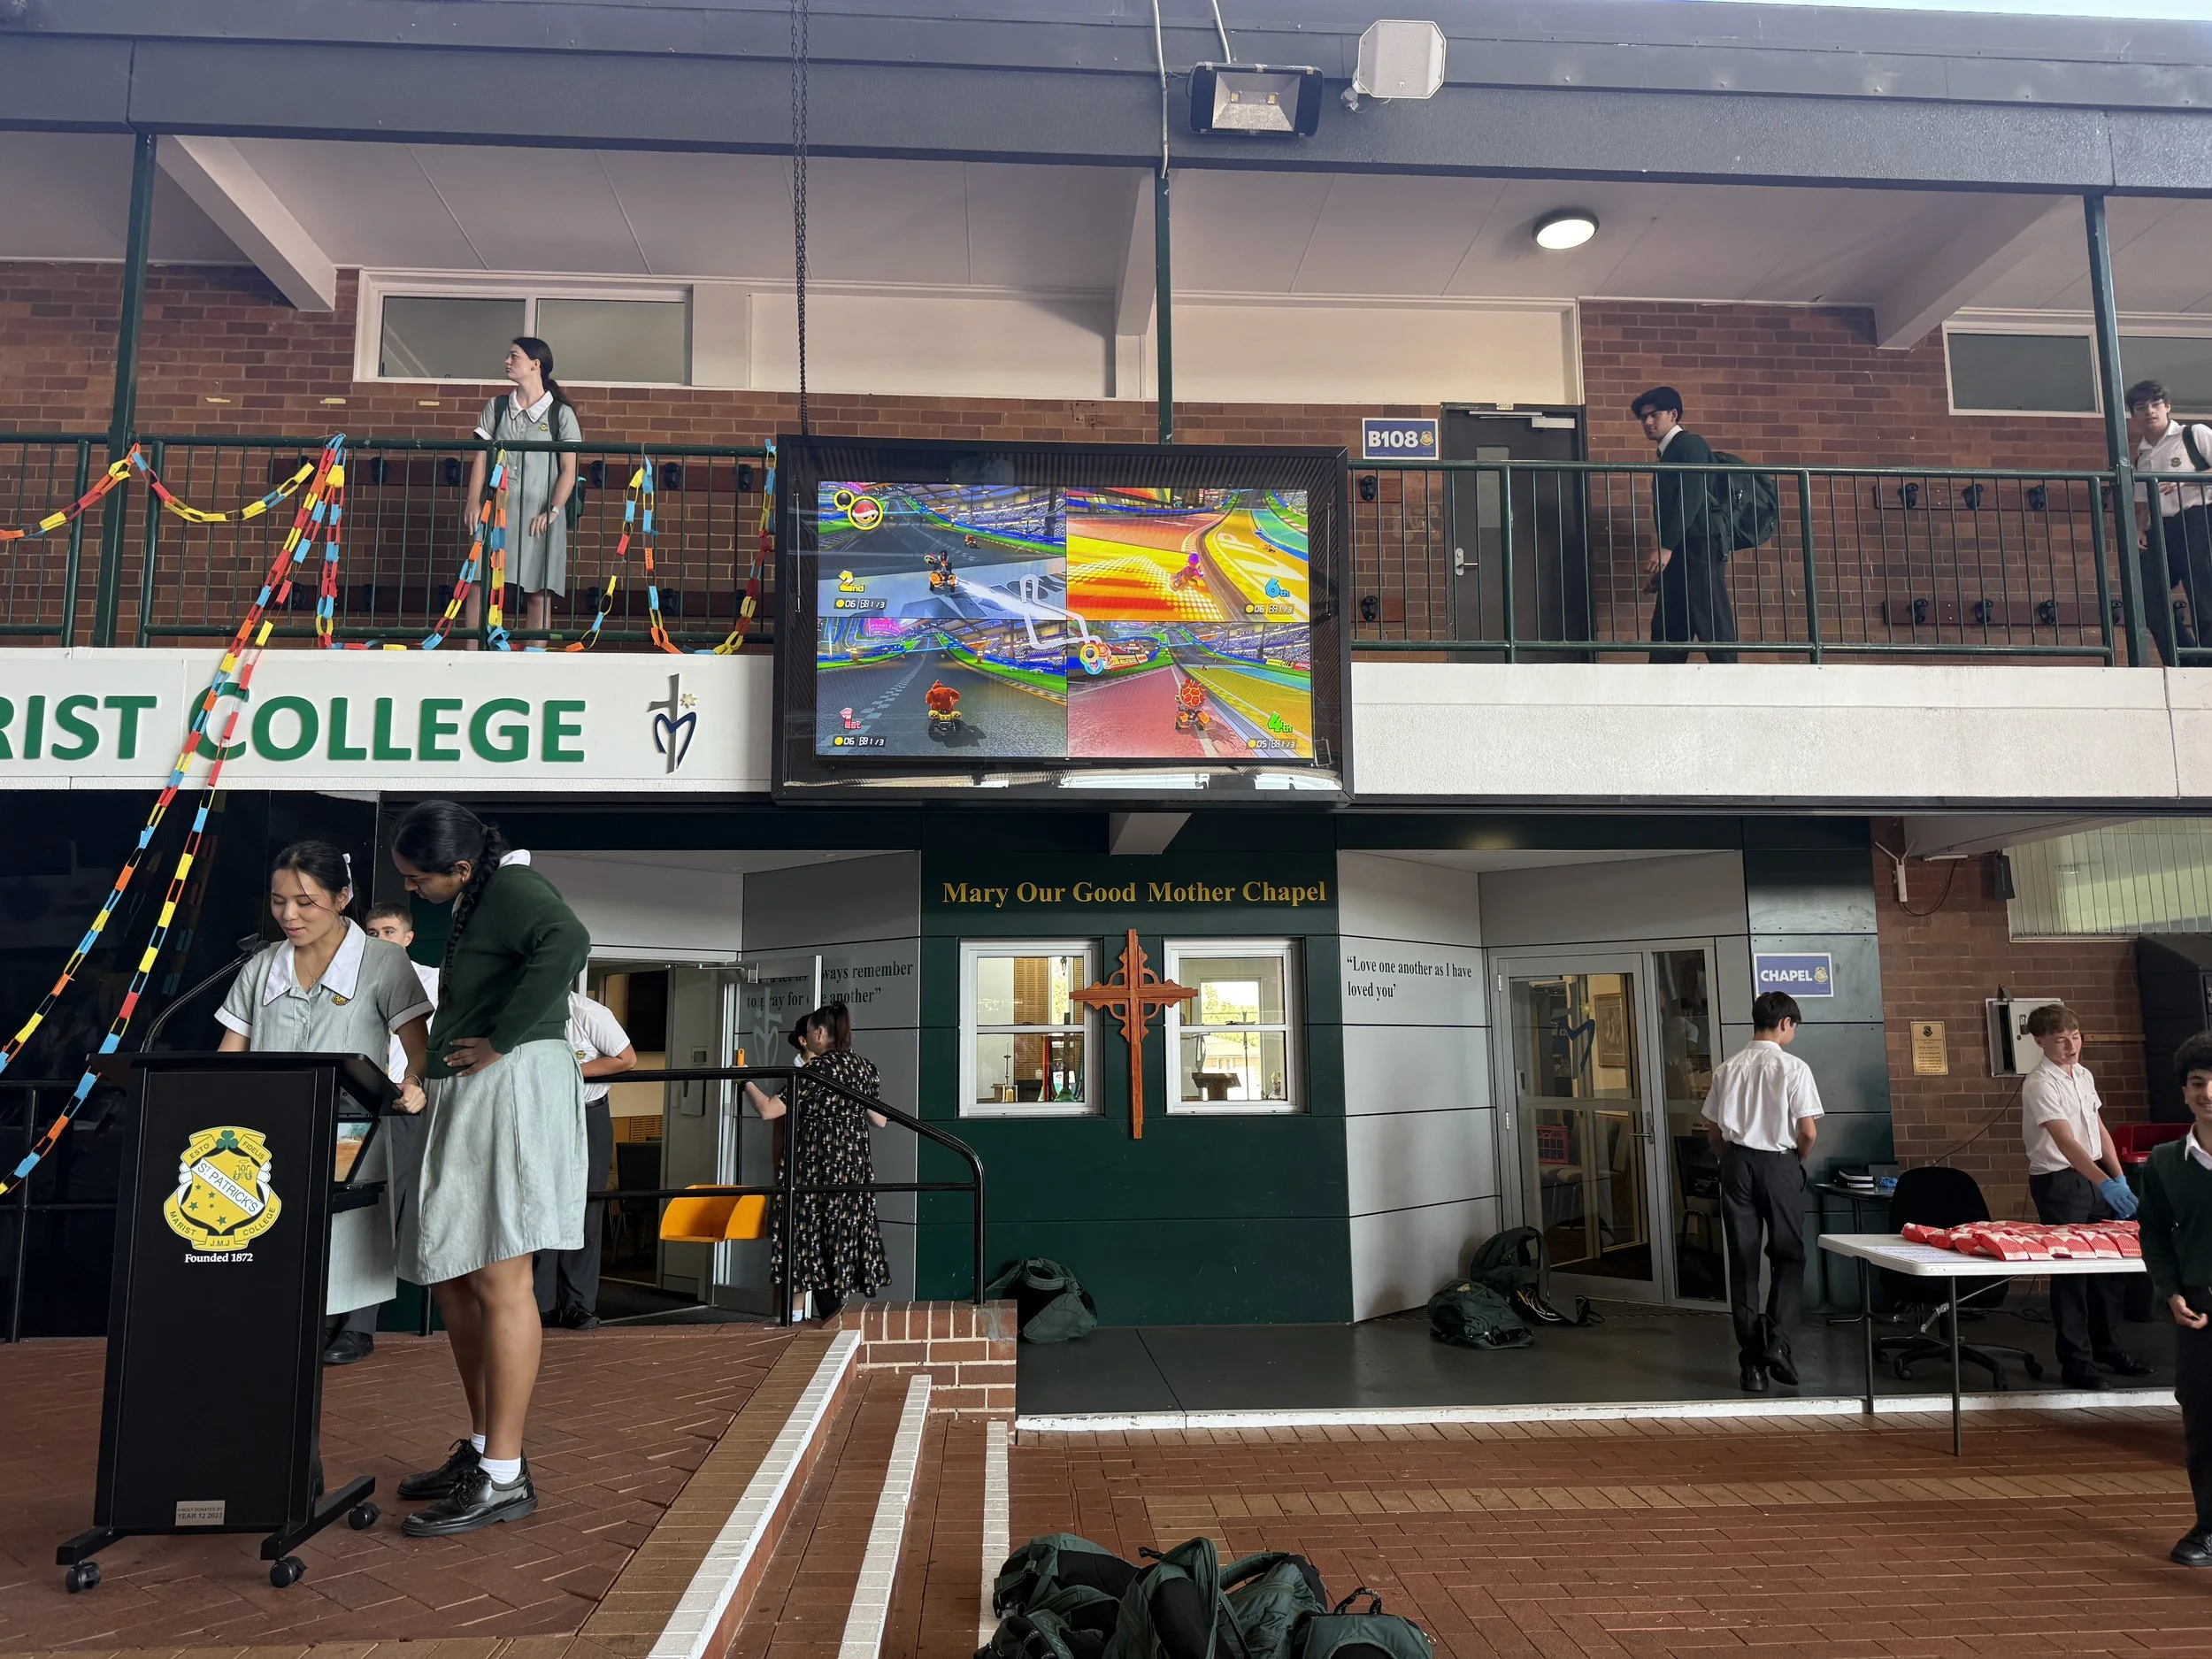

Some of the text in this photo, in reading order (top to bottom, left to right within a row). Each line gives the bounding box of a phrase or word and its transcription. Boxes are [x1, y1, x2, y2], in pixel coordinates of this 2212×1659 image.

[1368, 431, 1418, 448] B108
[839, 570, 864, 592] 2nd
[1265, 577, 1290, 598] 6th
[188, 682, 586, 763] COLLEGE
[840, 707, 861, 729] 1st
[1268, 711, 1293, 733] 4th
[942, 881, 1326, 908] Mary Our Good Mother Chapel
[821, 967, 849, 984] ways
[852, 960, 913, 979] remember
[1347, 956, 1472, 978] “Love one another as I have
[1760, 970, 1813, 982] CHAPEL
[747, 995, 757, 1008] to
[787, 991, 804, 1006] for
[1348, 981, 1373, 996] loved
[189, 1141, 265, 1160] ESTO FIDELIS
[209, 1171, 258, 1212] PATRICK'S
[169, 1207, 276, 1236] MARIST COLLEGE
[184, 1253, 253, 1263] Founded 1872
